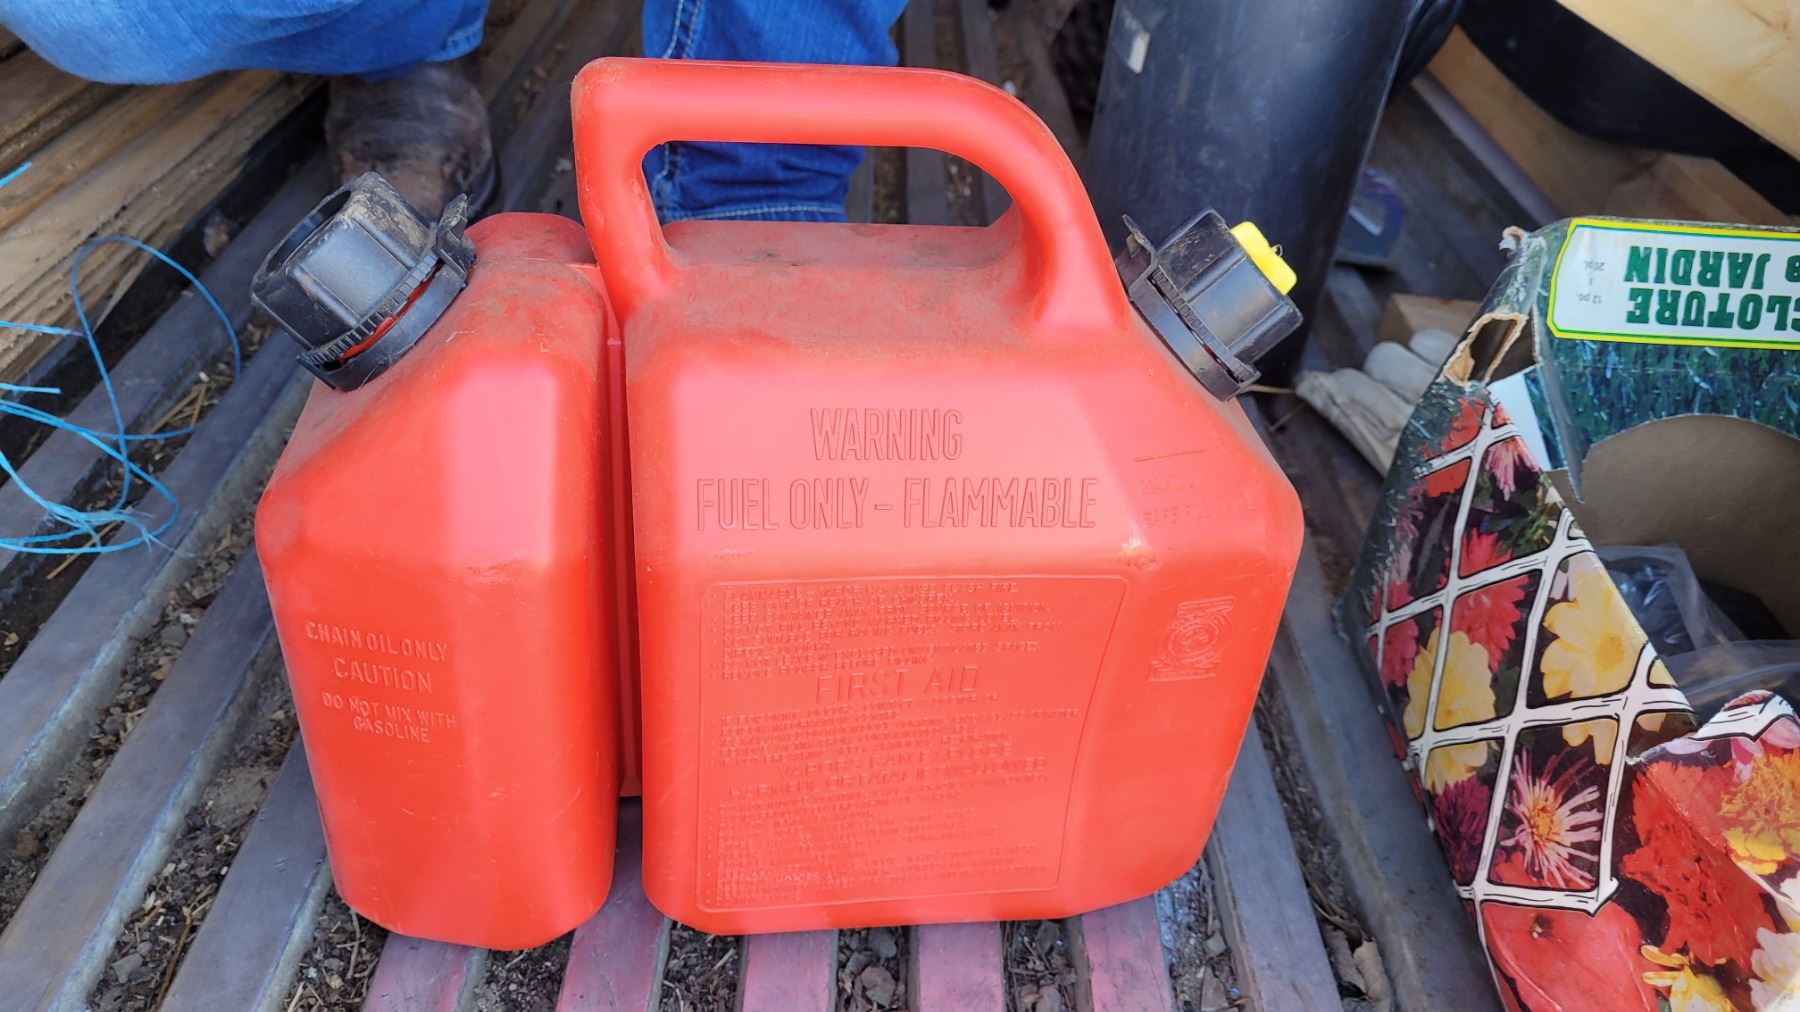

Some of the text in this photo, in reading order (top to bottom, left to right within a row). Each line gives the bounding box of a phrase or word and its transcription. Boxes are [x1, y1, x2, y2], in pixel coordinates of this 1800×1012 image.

[1623, 246, 1771, 290] JARDIN
[810, 408, 963, 461] WARNING
[697, 478, 779, 531] FUEL
[789, 478, 870, 529] ONLY
[903, 477, 1099, 529] FLAMMABLE
[304, 621, 448, 662] CHAIN OIL ONLY
[333, 657, 433, 694] CAUTION
[816, 668, 910, 703] FIRST
[924, 665, 979, 695] AID
[321, 691, 456, 729] DO NOT MIX WITH
[353, 715, 431, 743] GASOLINE
